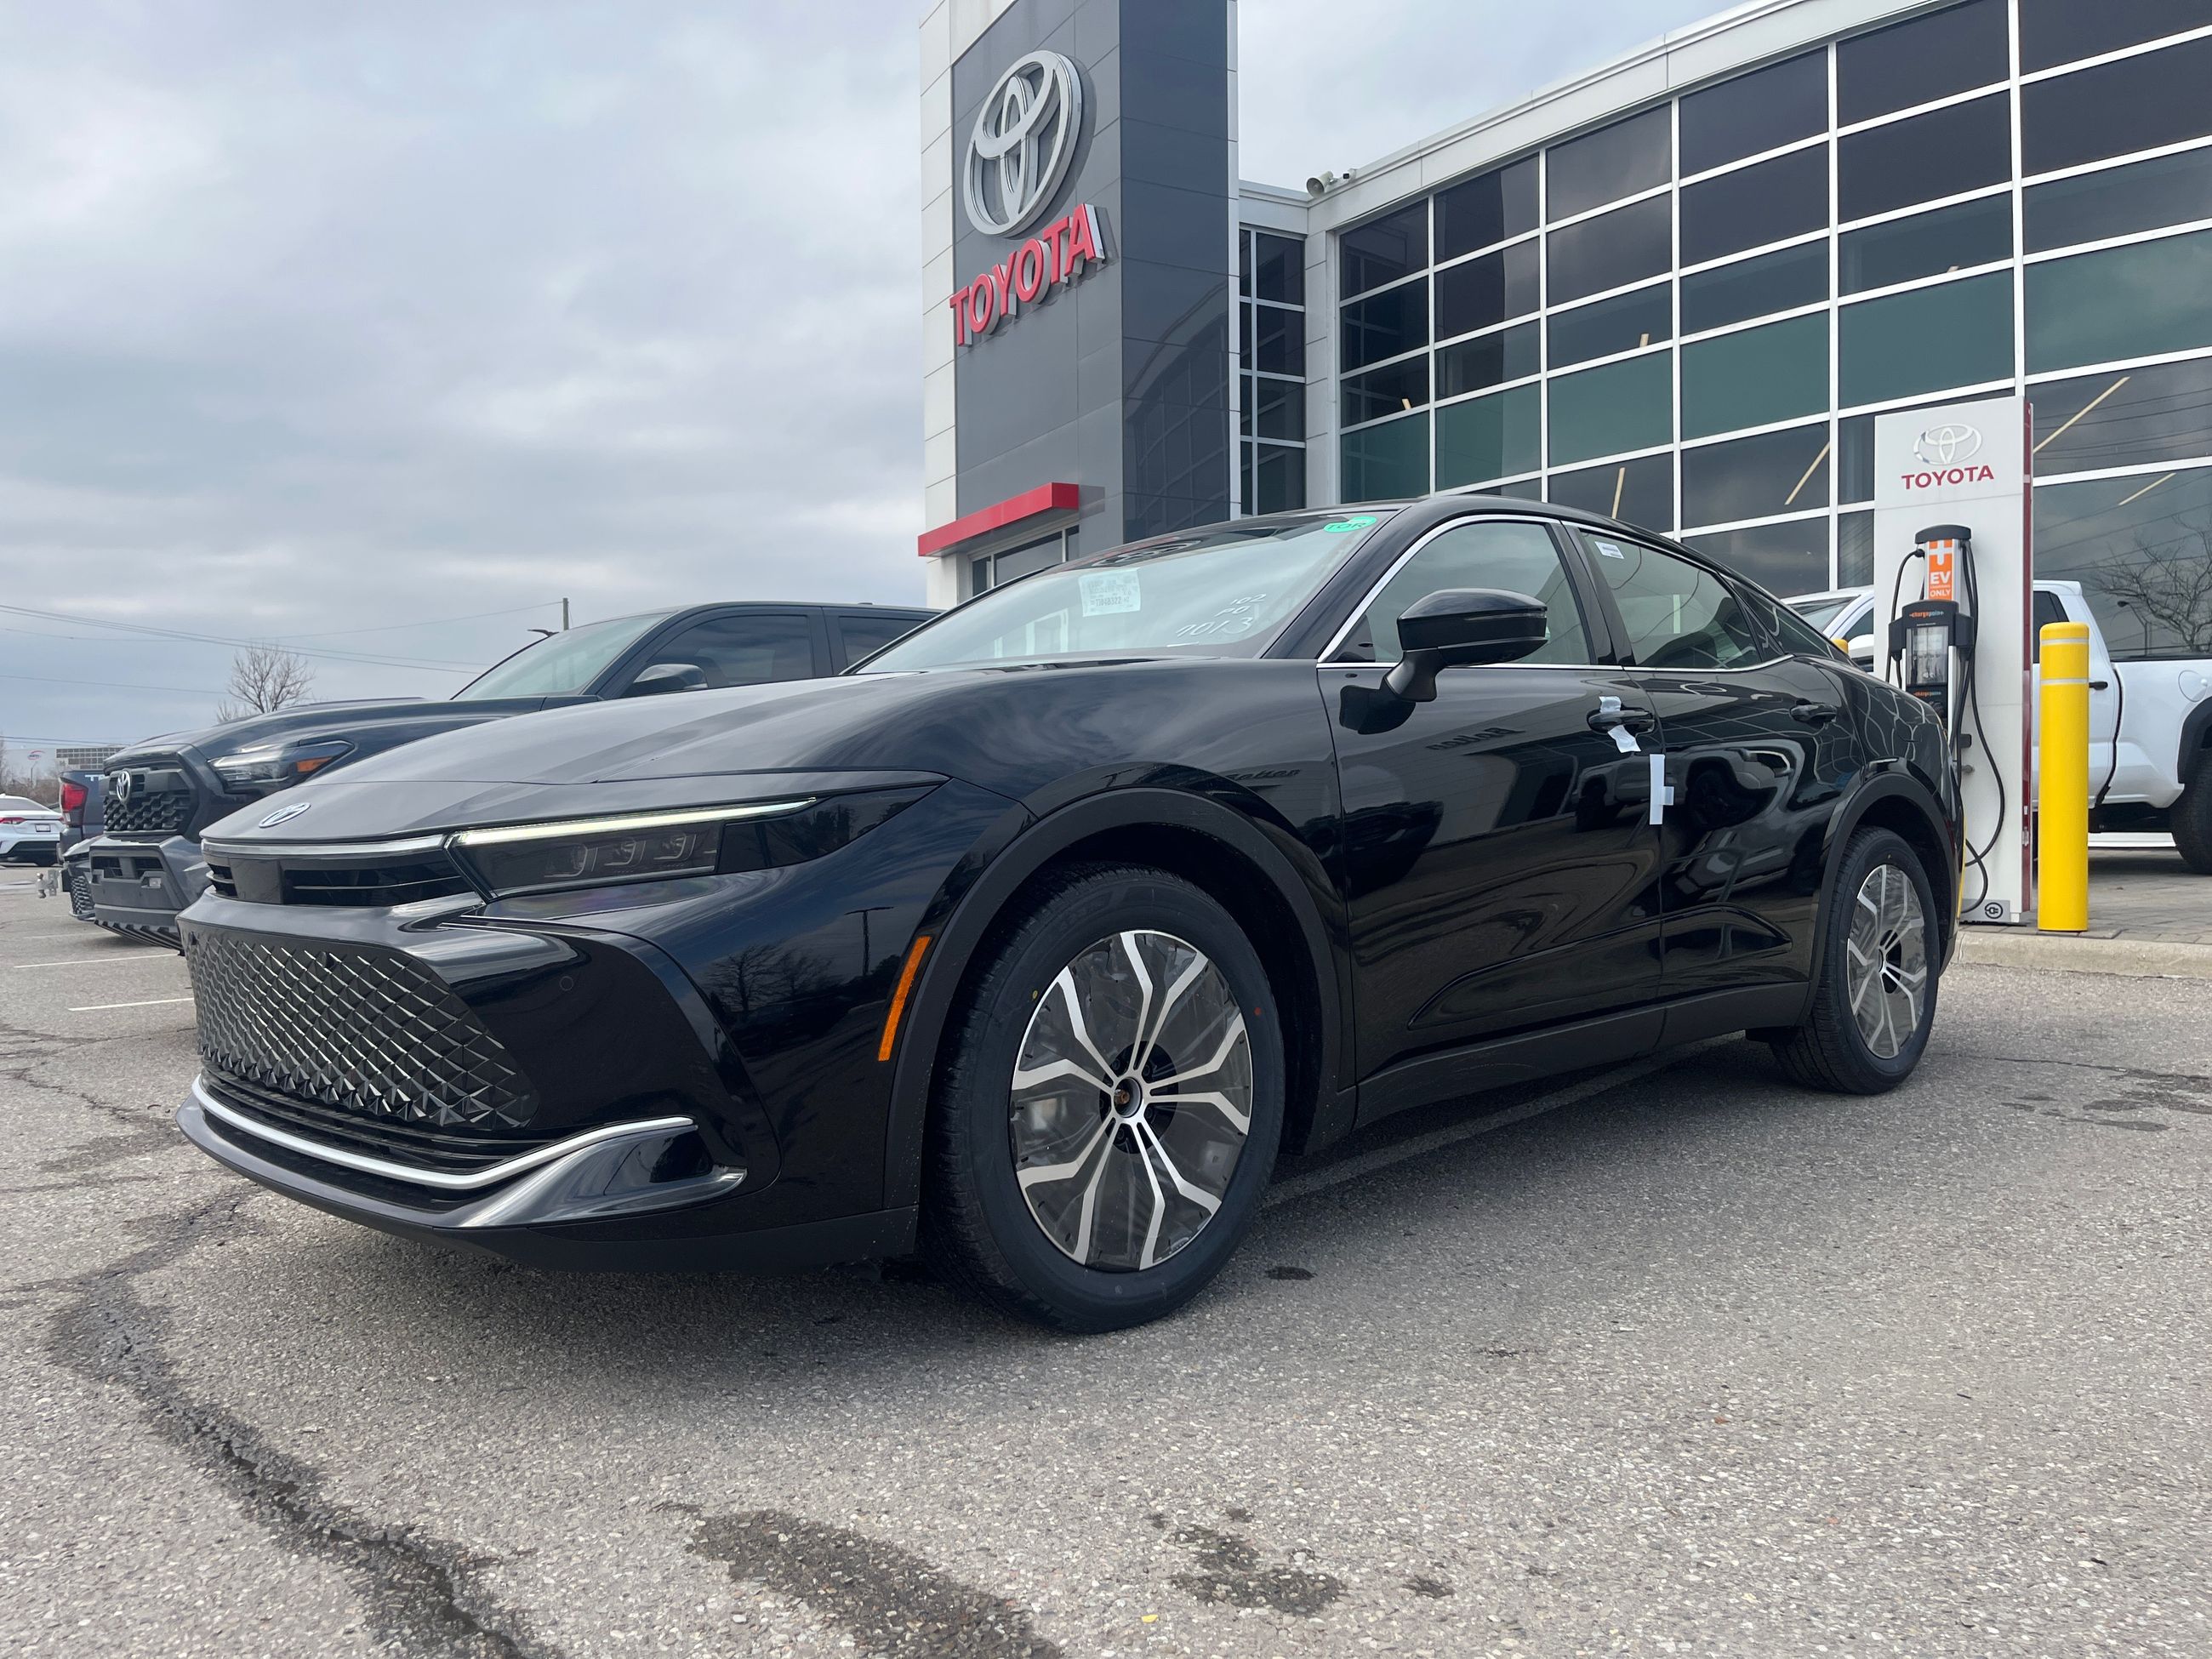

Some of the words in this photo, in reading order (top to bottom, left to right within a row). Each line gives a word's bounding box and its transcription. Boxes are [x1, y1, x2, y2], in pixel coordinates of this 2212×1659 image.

[949, 202, 1104, 346] TOYOTA
[1901, 465, 1994, 490] TOYOTA
[1930, 571, 1951, 584] EV
[1930, 588, 1952, 597] ONLY
